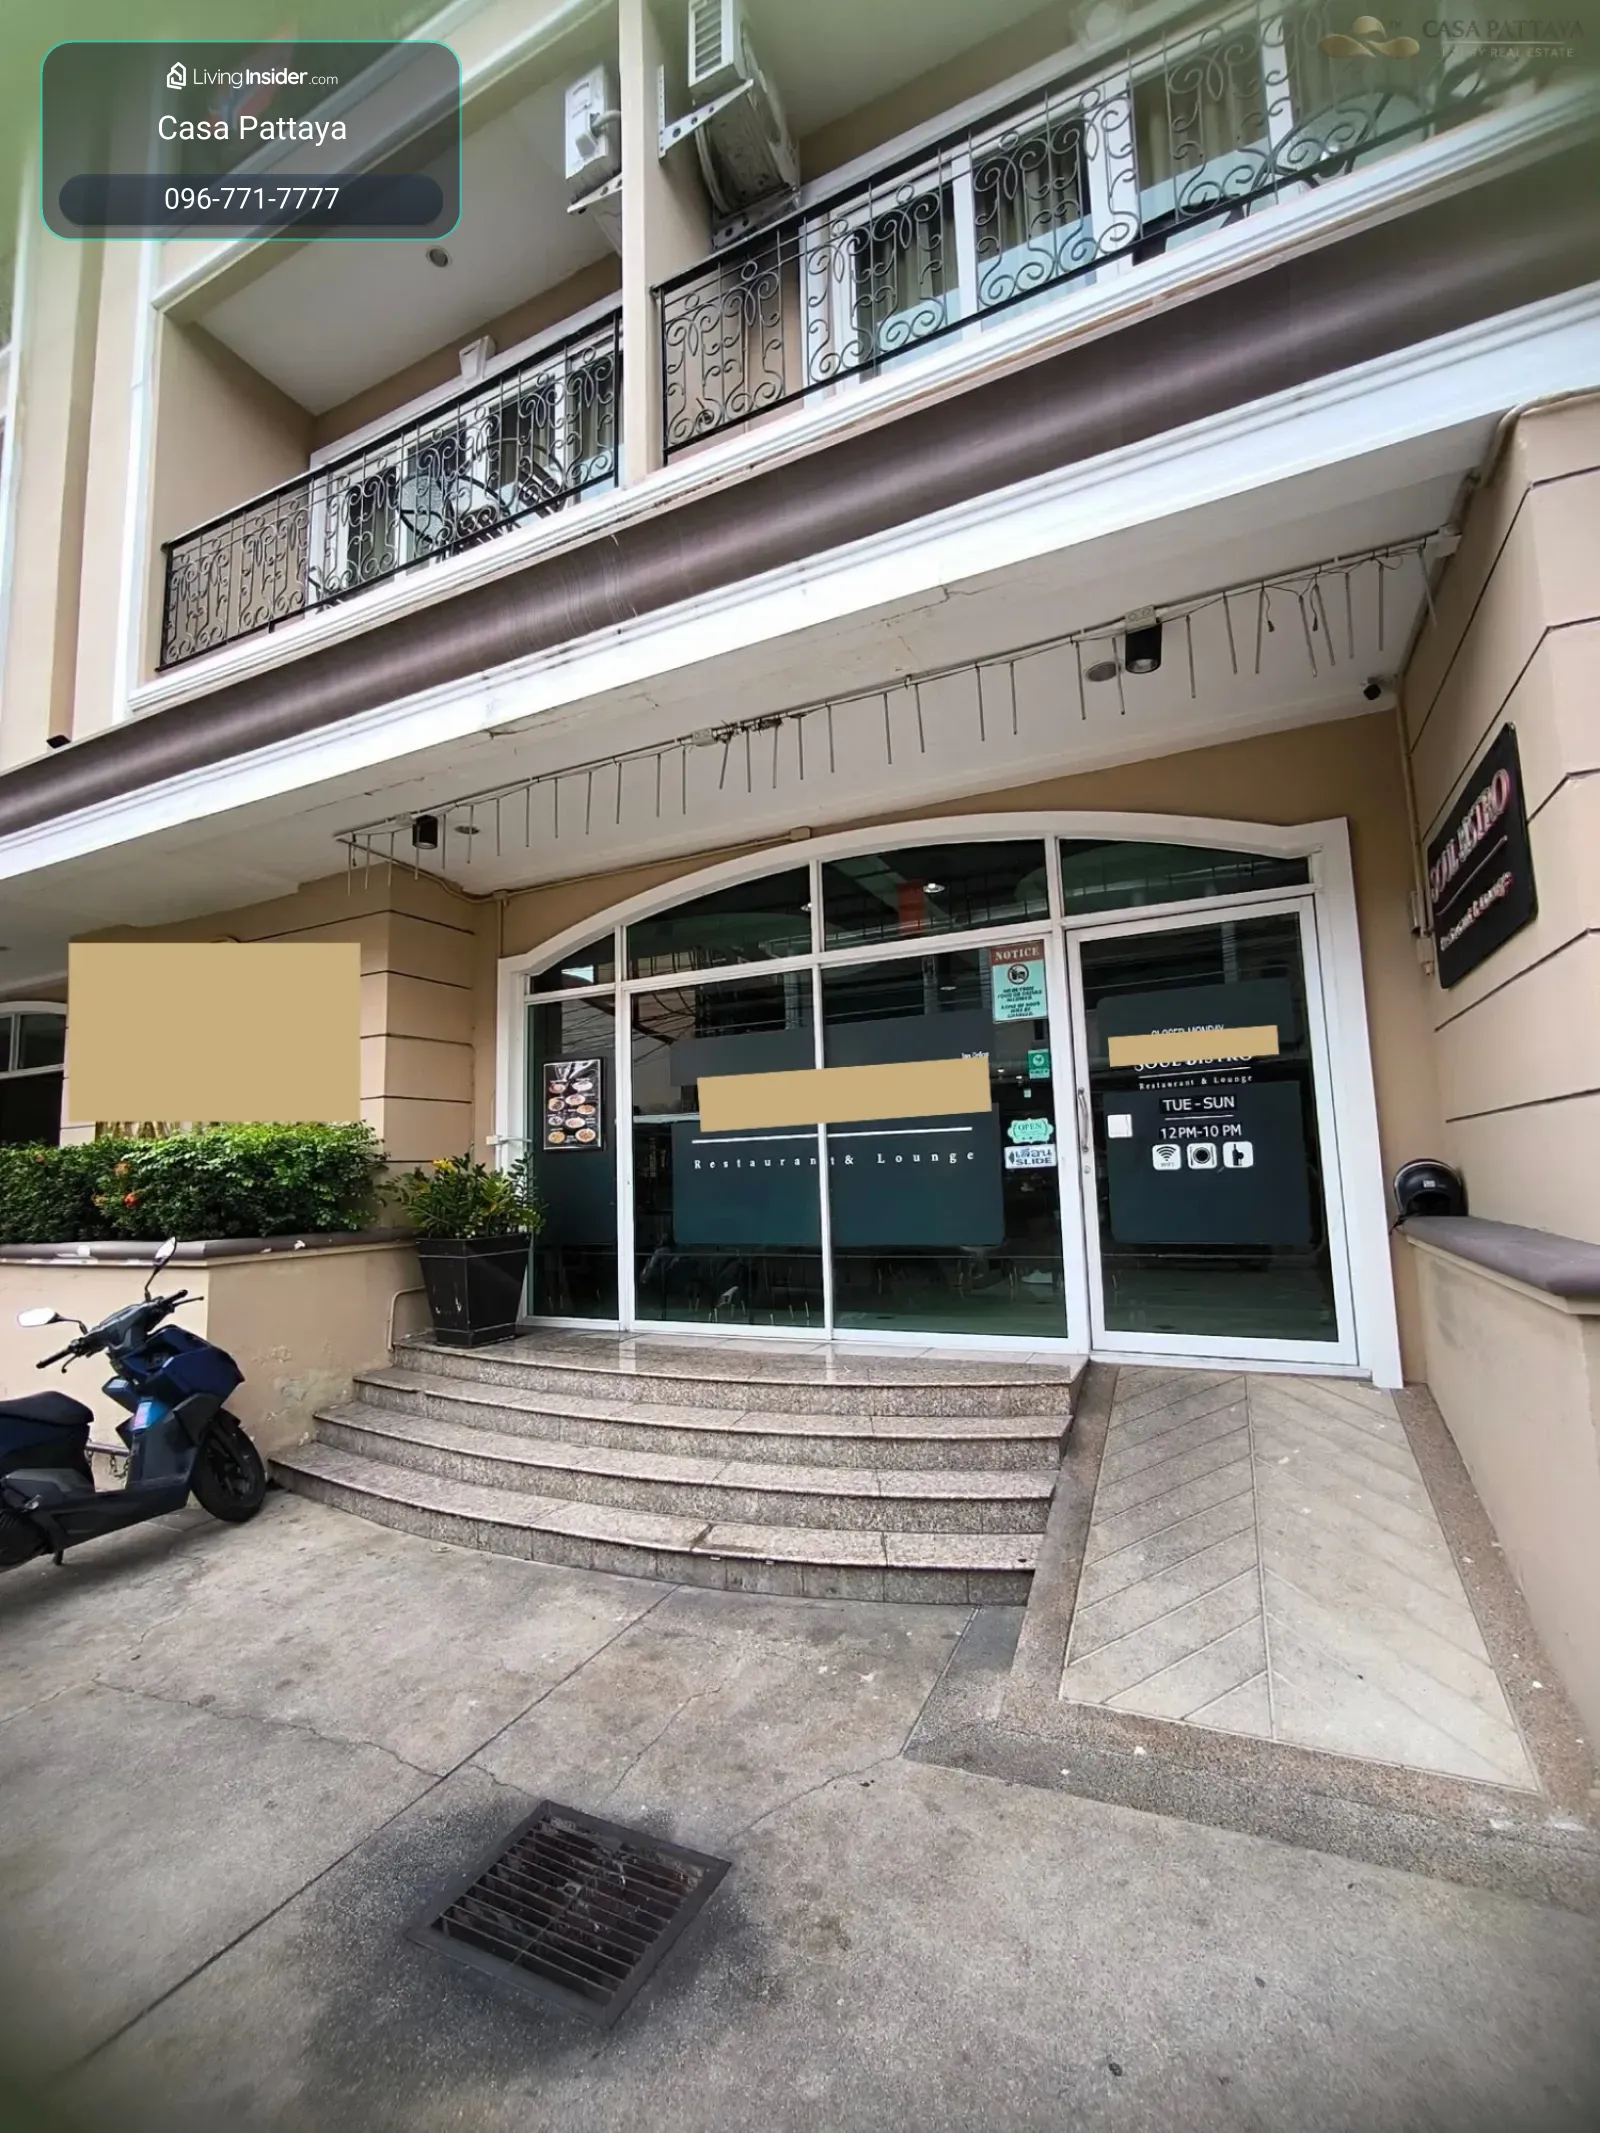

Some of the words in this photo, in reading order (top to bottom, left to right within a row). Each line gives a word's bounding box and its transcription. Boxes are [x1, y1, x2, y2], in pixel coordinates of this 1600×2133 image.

[994, 947, 1040, 961] NOTICE
[1138, 1079, 1195, 1091] Restaurant
[1201, 1078, 1208, 1086] &
[1213, 1075, 1253, 1084] Lounge
[1162, 1098, 1192, 1111] TUE
[1203, 1096, 1235, 1110] SUN
[1017, 1122, 1042, 1131] OPEN
[1222, 1124, 1242, 1137] PM
[693, 1155, 837, 1170] Restaurant
[844, 1154, 855, 1165] &
[876, 1149, 974, 1164] Lounge
[1015, 1157, 1053, 1166] SLIDE
